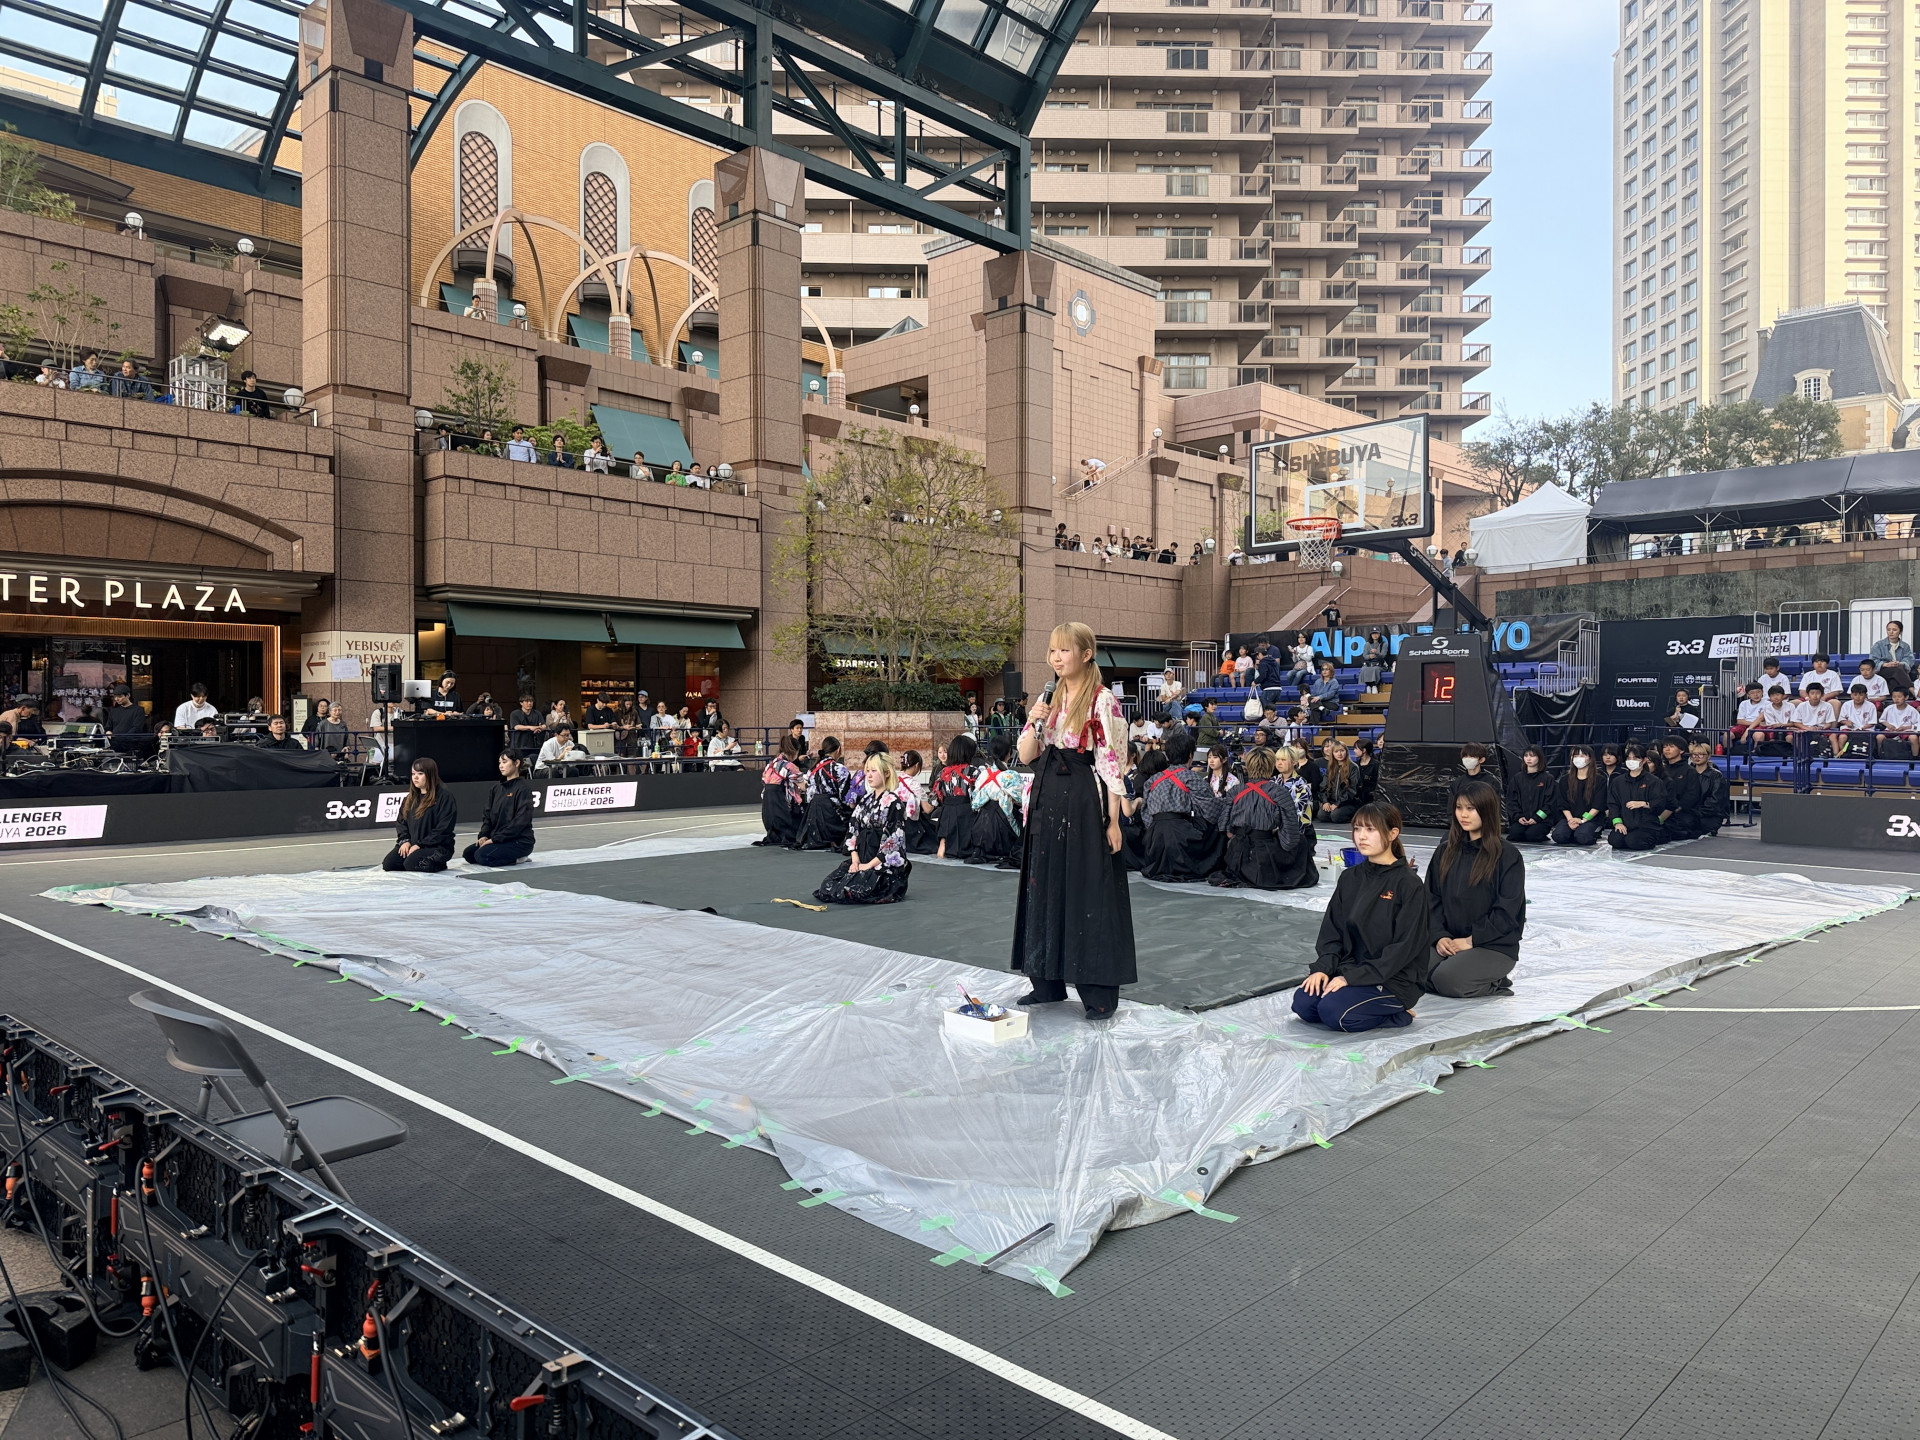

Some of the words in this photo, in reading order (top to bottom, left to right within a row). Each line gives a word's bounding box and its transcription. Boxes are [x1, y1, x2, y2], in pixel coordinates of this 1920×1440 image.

[1289, 443, 1381, 472] SHIBUYA
[1391, 513, 1418, 528] 3x3
[105, 580, 246, 613] PLAZA
[346, 640, 389, 652] YEBISU
[1310, 629, 1410, 664] Alpn
[1442, 648, 1470, 656] Sports
[1665, 639, 1705, 655] 3x3
[1433, 676, 1455, 699] 12
[1616, 698, 1650, 708] Wilson
[553, 786, 612, 797] CHALLENGER
[325, 799, 372, 820] 3x3
[552, 798, 589, 809] SHIBUYA
[590, 796, 615, 806] 2026
[0, 811, 62, 824] LENGER
[25, 825, 67, 837] 2026
